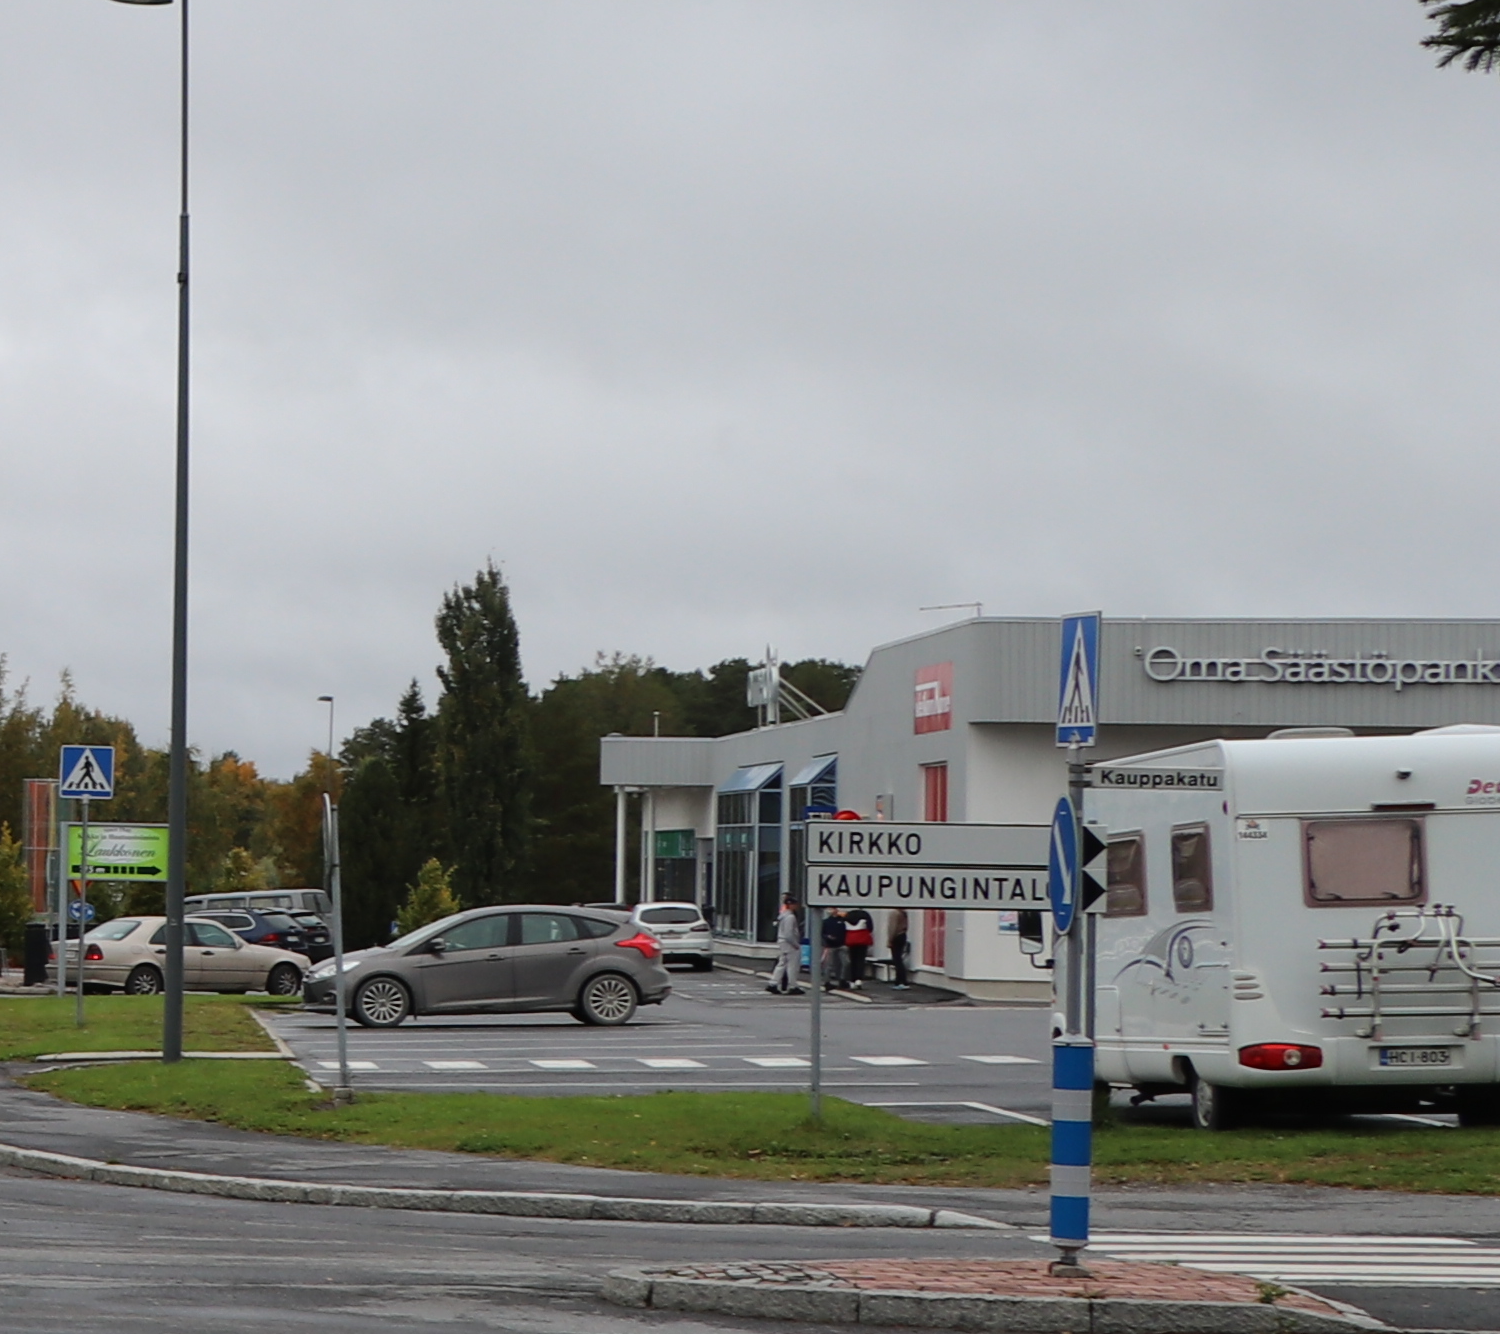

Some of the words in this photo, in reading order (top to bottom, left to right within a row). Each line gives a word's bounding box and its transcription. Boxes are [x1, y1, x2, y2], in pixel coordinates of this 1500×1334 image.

[1144, 645, 1247, 682] Oma
[1258, 645, 1500, 692] Säästöpank
[1100, 769, 1218, 788] Kauppakatu
[818, 831, 922, 856] KIRKKO
[818, 873, 1051, 902] KAUPUNGINTAL
